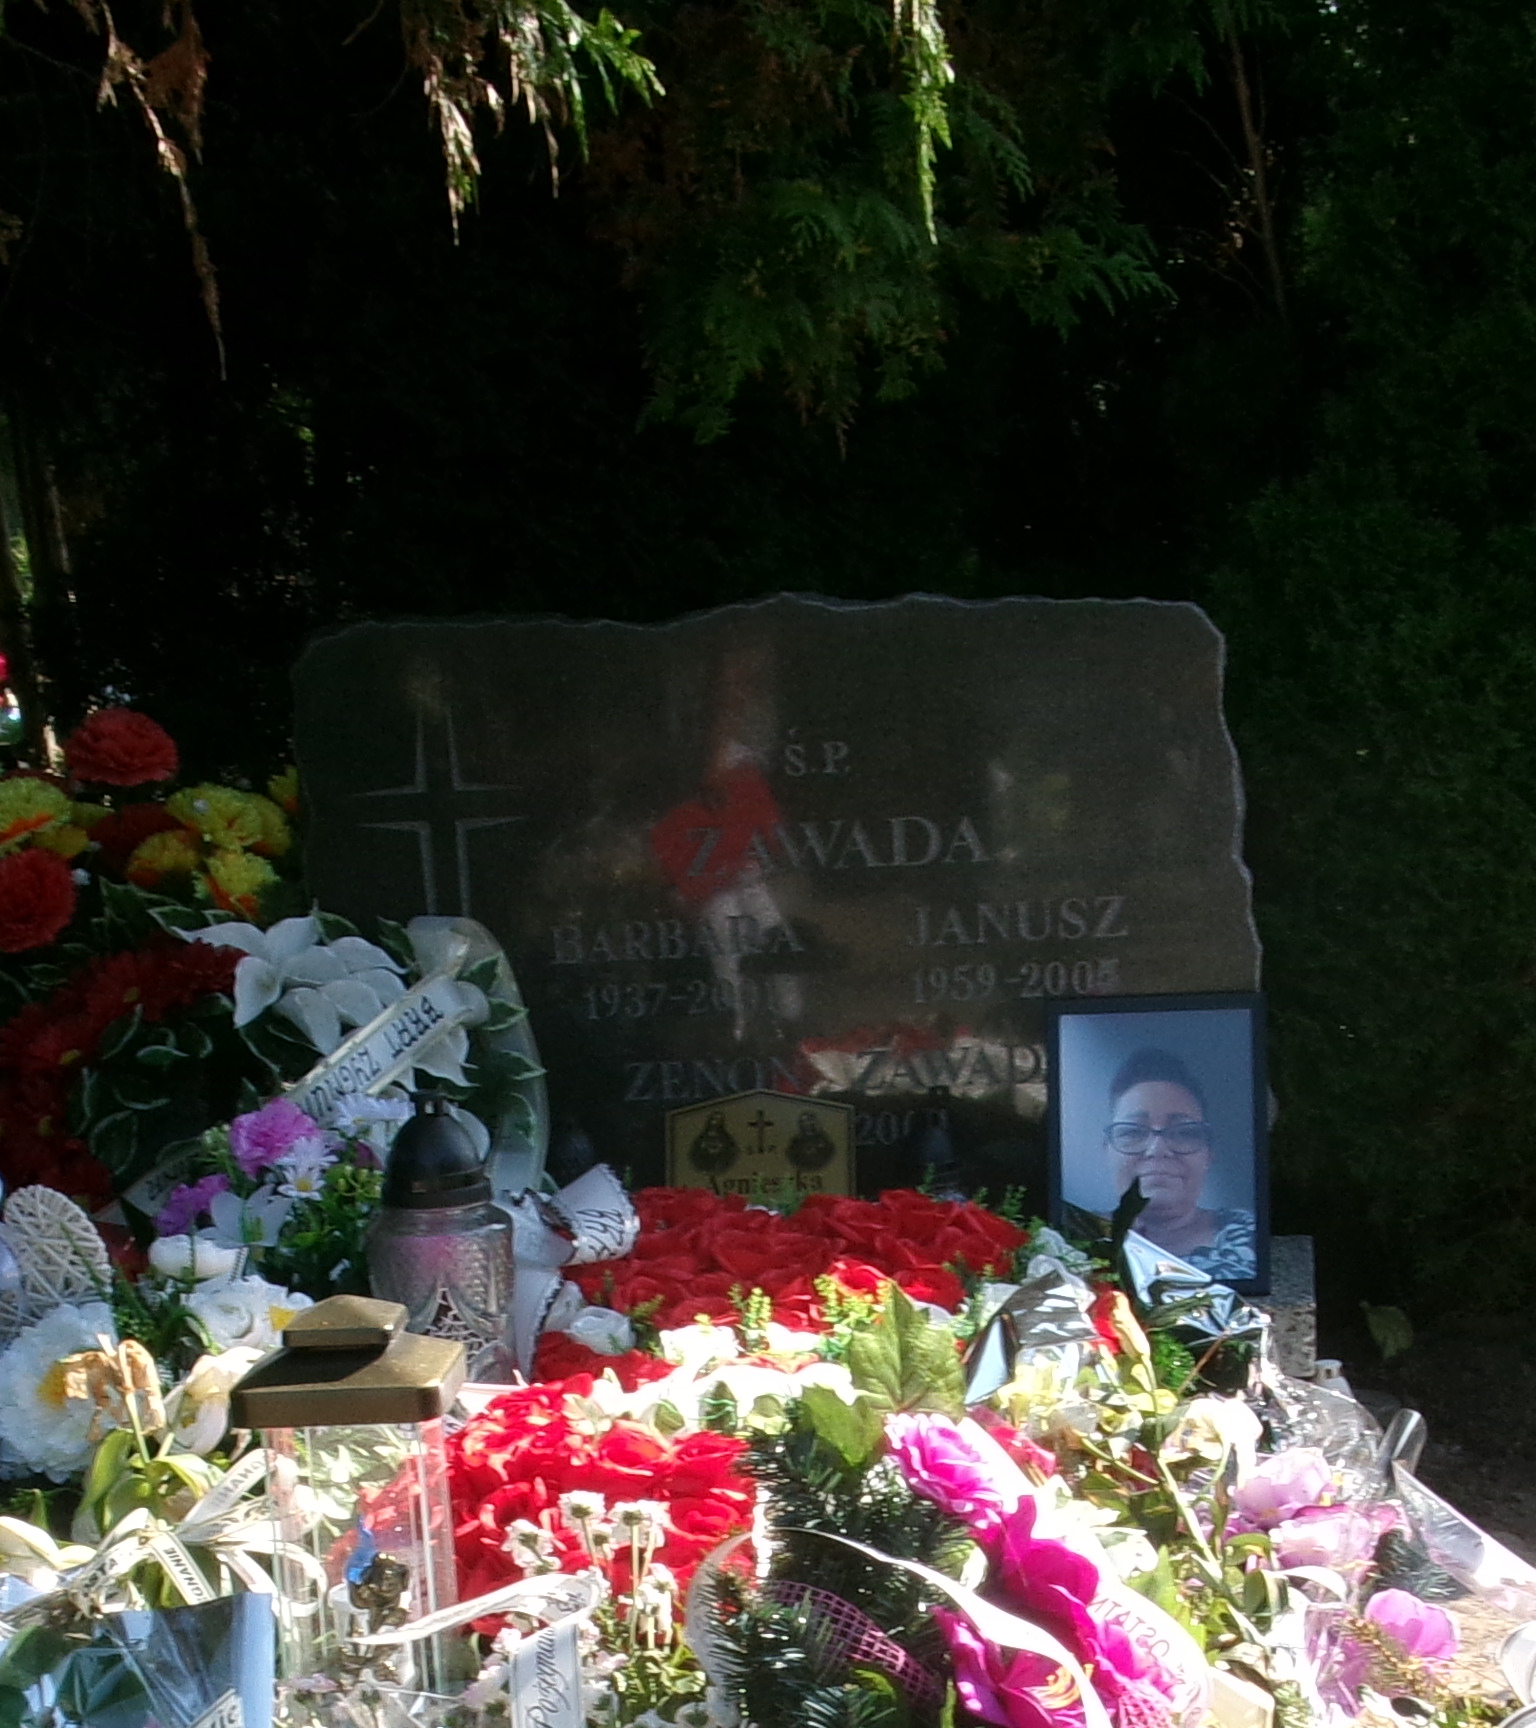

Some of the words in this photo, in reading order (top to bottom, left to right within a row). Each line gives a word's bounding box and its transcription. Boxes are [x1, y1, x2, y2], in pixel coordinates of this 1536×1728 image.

[683, 815, 991, 877] ZAWADA
[550, 915, 805, 965] BARBARA
[908, 894, 1130, 946] JANUSZ
[388, 995, 446, 1060] BRAT
[624, 1056, 800, 1101] ZENON
[856, 1044, 1047, 1090] ZAWAD
